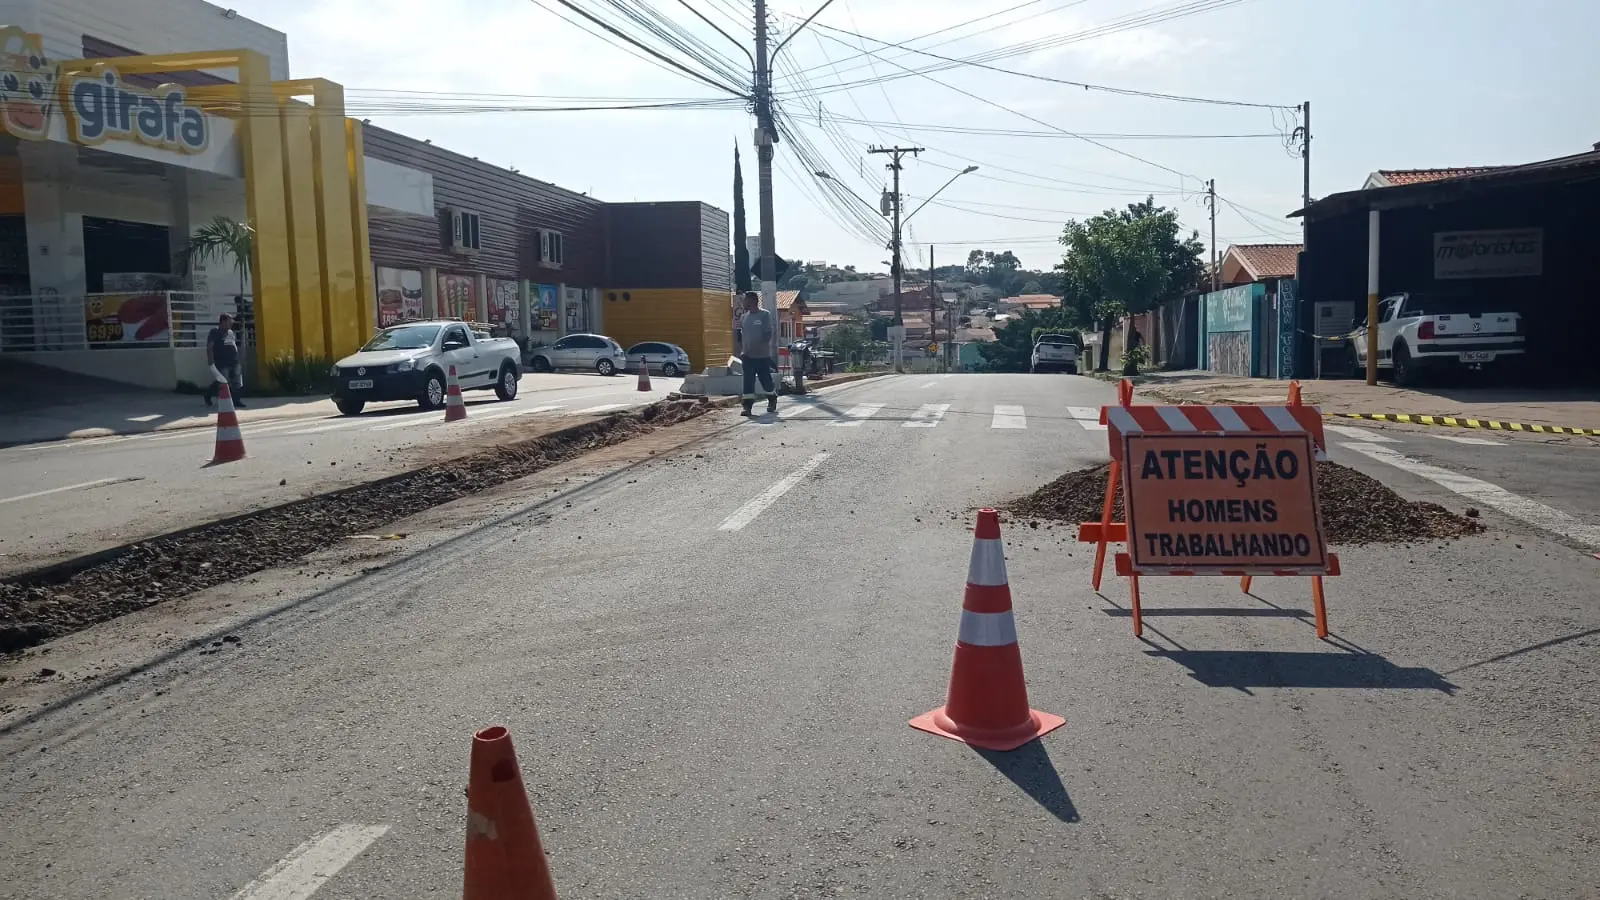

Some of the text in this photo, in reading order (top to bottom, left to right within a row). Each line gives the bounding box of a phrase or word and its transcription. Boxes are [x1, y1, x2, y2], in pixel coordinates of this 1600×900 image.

[74, 72, 205, 147] girafa
[1141, 443, 1299, 488] ATENÇÃO
[1168, 499, 1278, 522] HOMENS
[1144, 533, 1310, 557] TRABALHANDO
